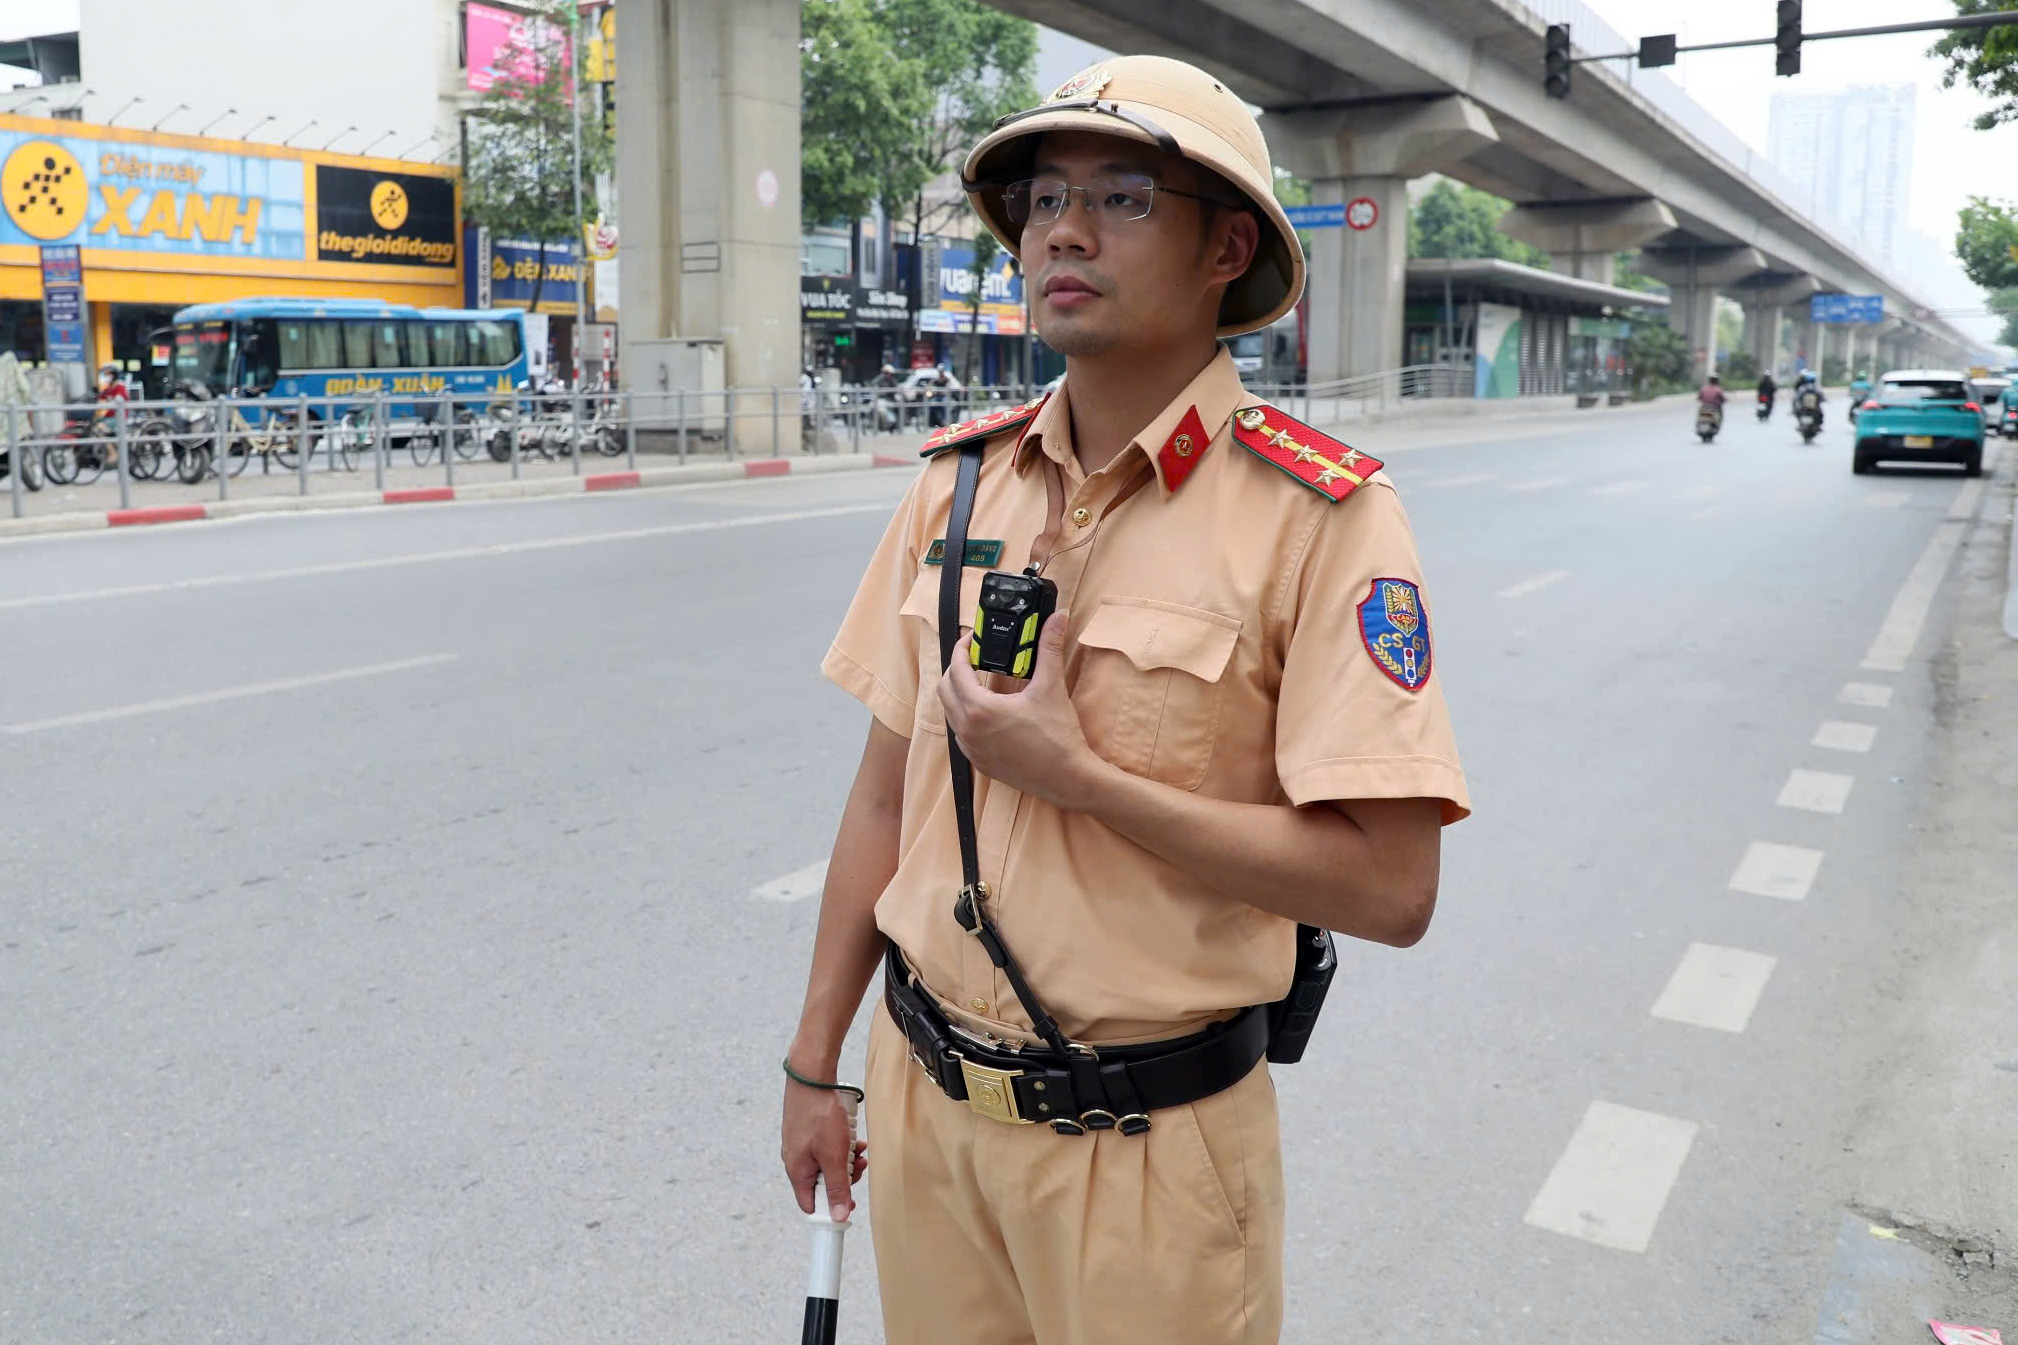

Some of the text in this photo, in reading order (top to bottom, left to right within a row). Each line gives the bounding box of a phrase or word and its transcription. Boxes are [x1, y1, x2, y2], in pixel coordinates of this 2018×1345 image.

[101, 153, 206, 186] Điện máy
[90, 185, 262, 244] XANH
[320, 230, 455, 262] thegioididong
[1378, 633, 1426, 653] CS GT
